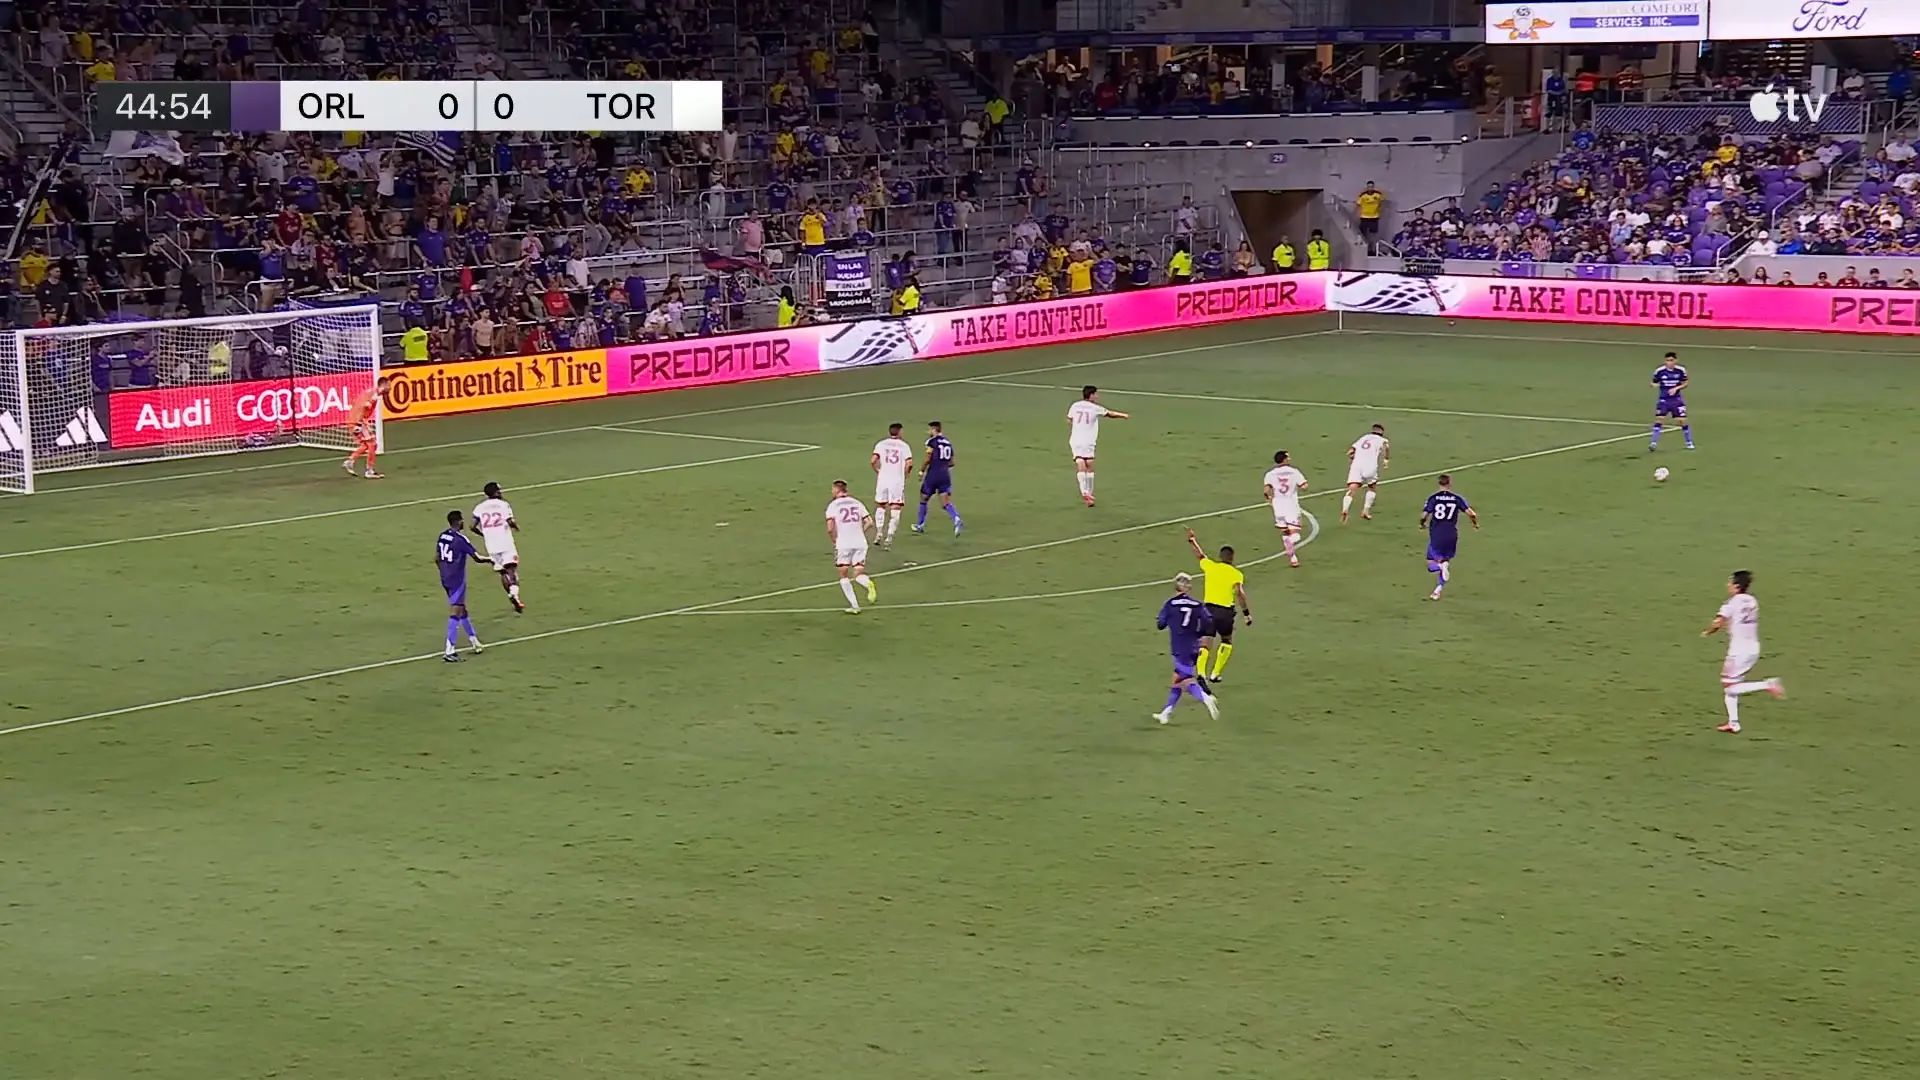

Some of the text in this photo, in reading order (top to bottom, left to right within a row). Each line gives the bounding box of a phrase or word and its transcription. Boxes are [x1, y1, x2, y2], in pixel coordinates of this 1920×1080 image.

[1596, 17, 1672, 27] SERVICES INC.
[1793, 0, 1868, 31] Ford
[1177, 281, 1298, 318] PREDATOR
[1489, 285, 1714, 320] TAKE CONTROL
[1831, 297, 1920, 326] PRE
[951, 303, 1107, 346] TAKE CONTROL
[630, 338, 791, 384] PREDATOR
[382, 355, 602, 413] Continental Tire
[135, 397, 211, 431] Audi
[1076, 411, 1090, 424] 71
[938, 444, 952, 460] 10
[1361, 439, 1371, 450] 6
[884, 448, 900, 464] 13
[1278, 477, 1290, 494] 3
[481, 512, 503, 529] 22
[839, 506, 860, 523] 25
[1434, 503, 1457, 519] 87
[438, 542, 453, 562] 14
[1180, 607, 1192, 627] 7
